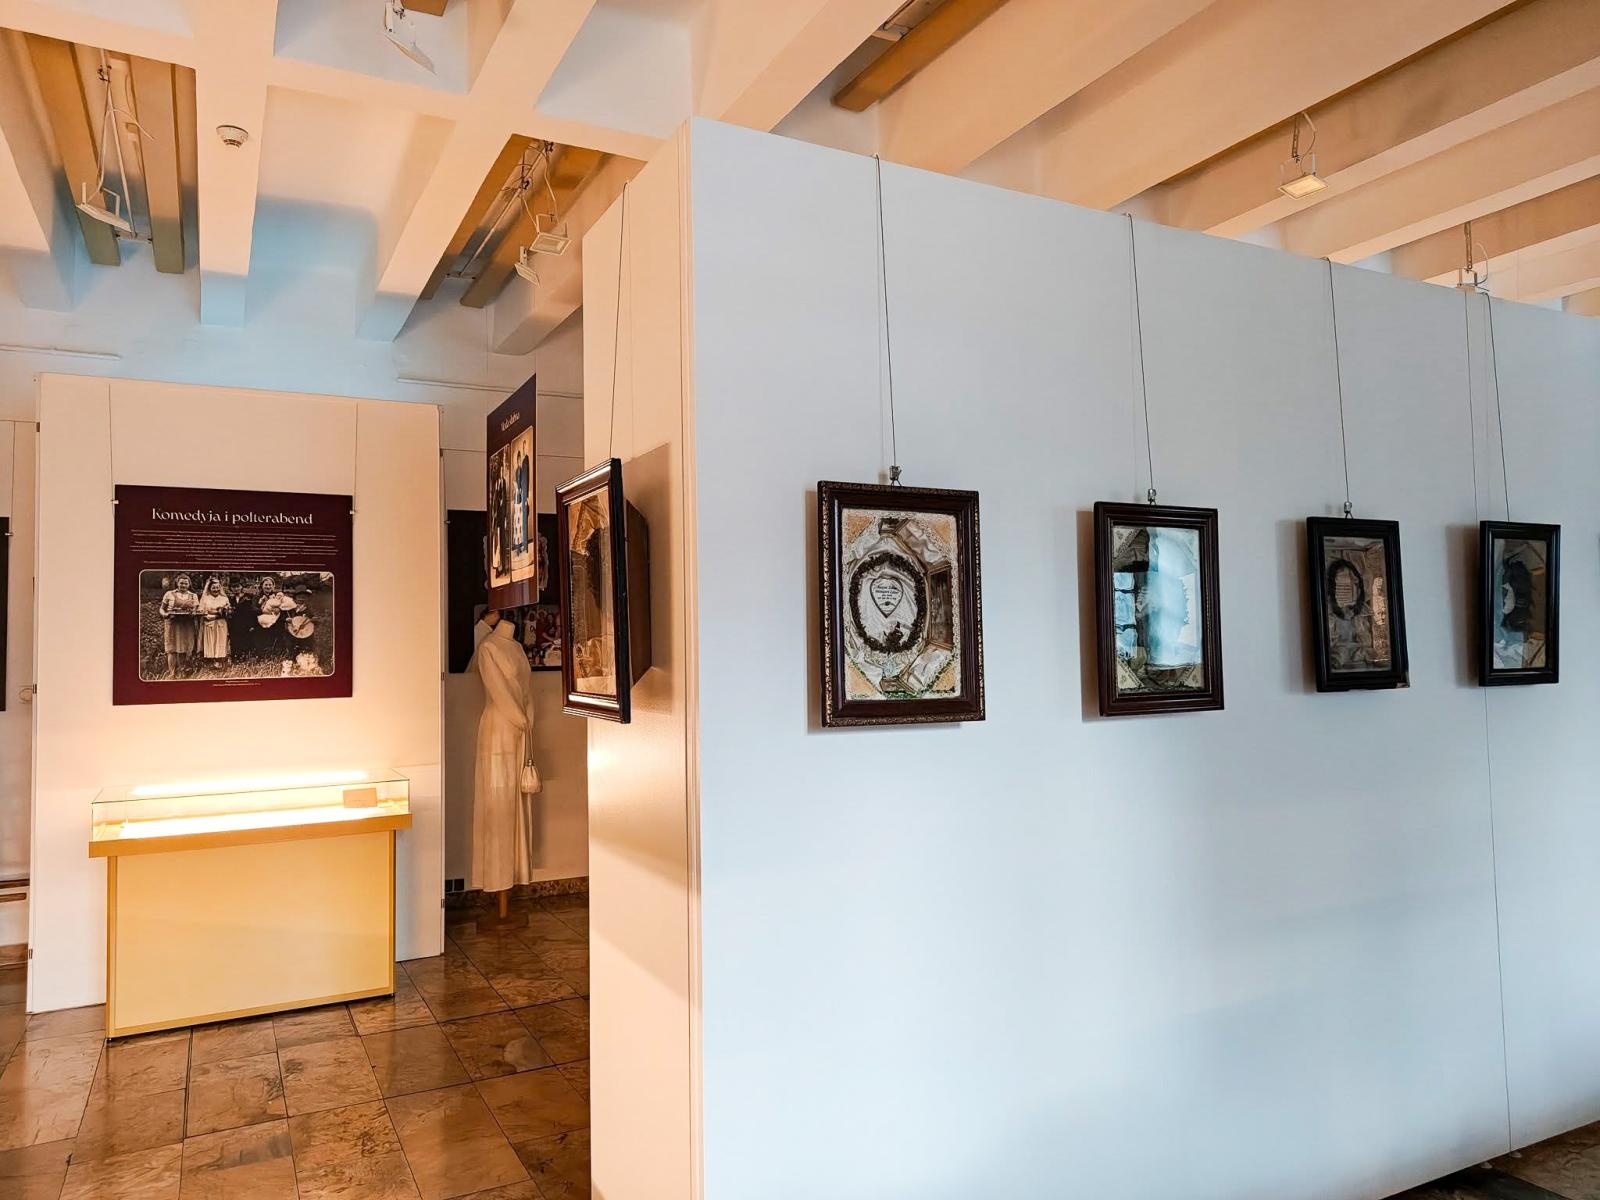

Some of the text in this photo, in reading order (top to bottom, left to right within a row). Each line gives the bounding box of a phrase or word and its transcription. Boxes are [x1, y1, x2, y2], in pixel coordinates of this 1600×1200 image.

[152, 507, 314, 525] Komedyja i polterabend
